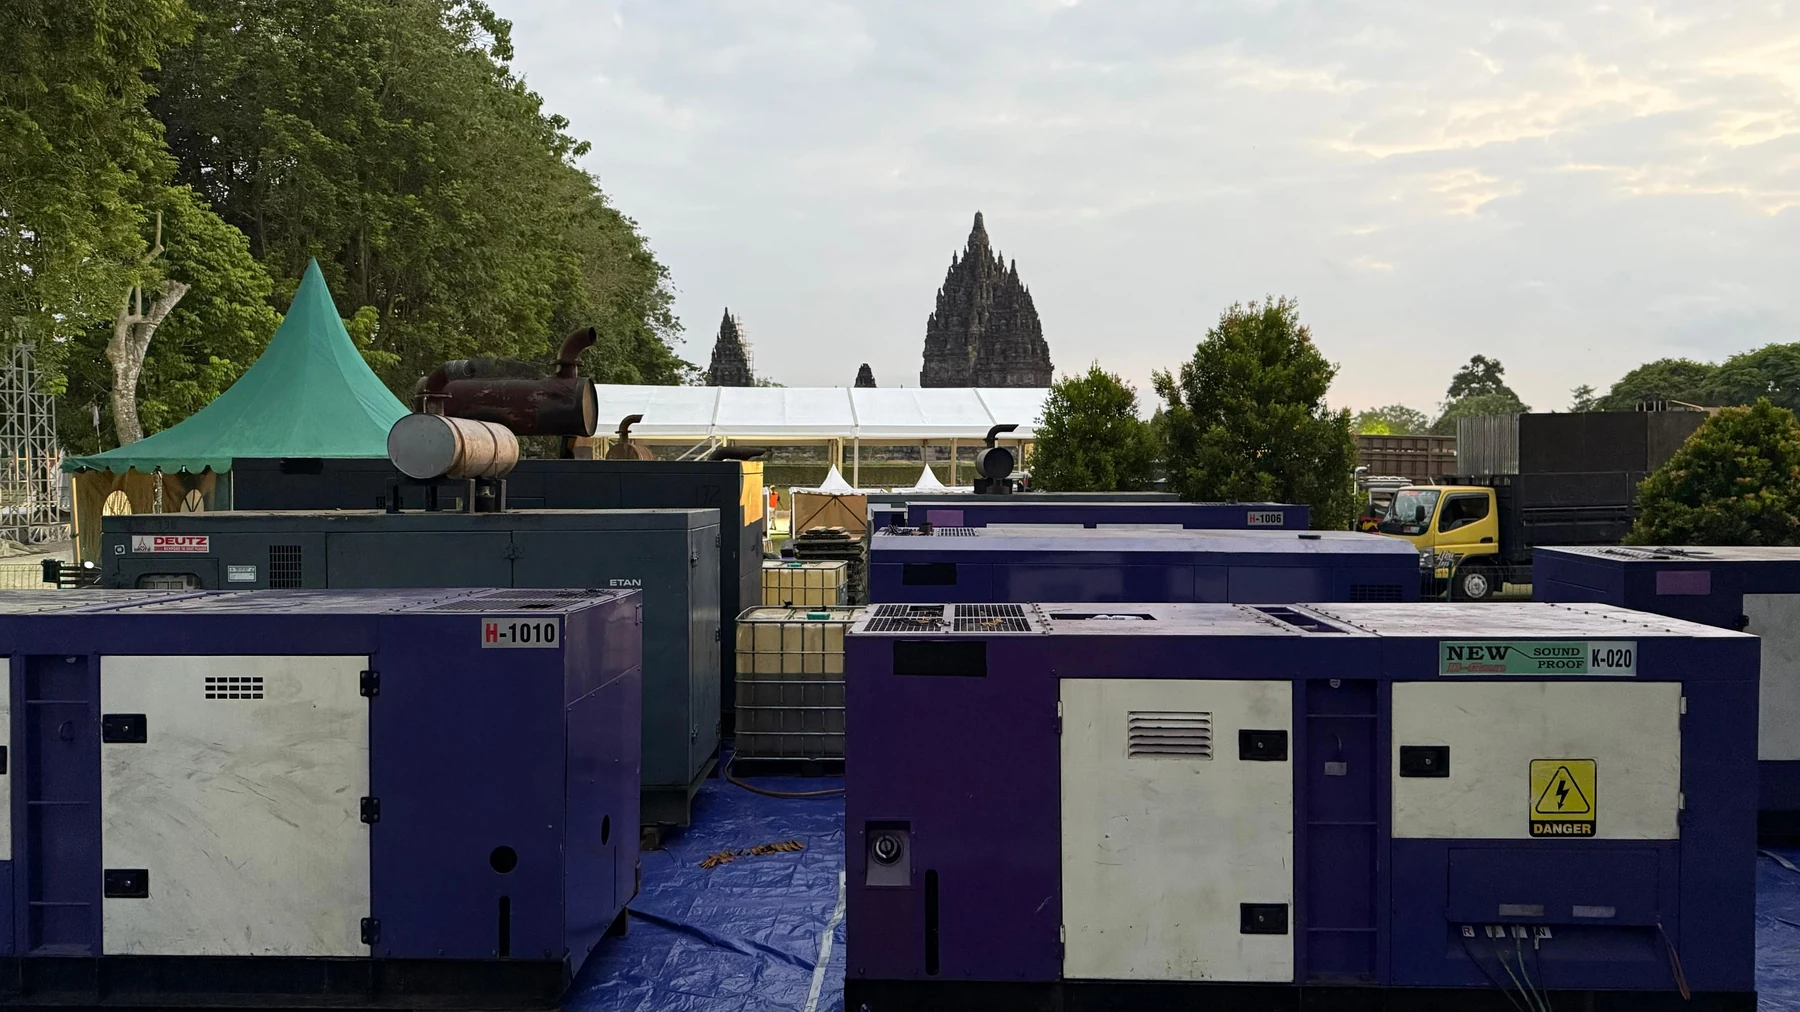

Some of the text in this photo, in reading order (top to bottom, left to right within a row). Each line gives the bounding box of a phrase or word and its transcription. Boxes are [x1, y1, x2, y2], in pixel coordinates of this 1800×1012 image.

[1249, 513, 1282, 523] H-1006
[153, 536, 207, 546] DEUTZ
[609, 578, 642, 587] ETAN
[485, 622, 555, 643] H-1010
[1446, 646, 1510, 661] NEW
[1533, 647, 1580, 657] SOUND
[1591, 648, 1632, 668] K-020
[1537, 660, 1585, 669] PROOF
[1533, 823, 1592, 834] DANGER
[1463, 927, 1472, 936] R
